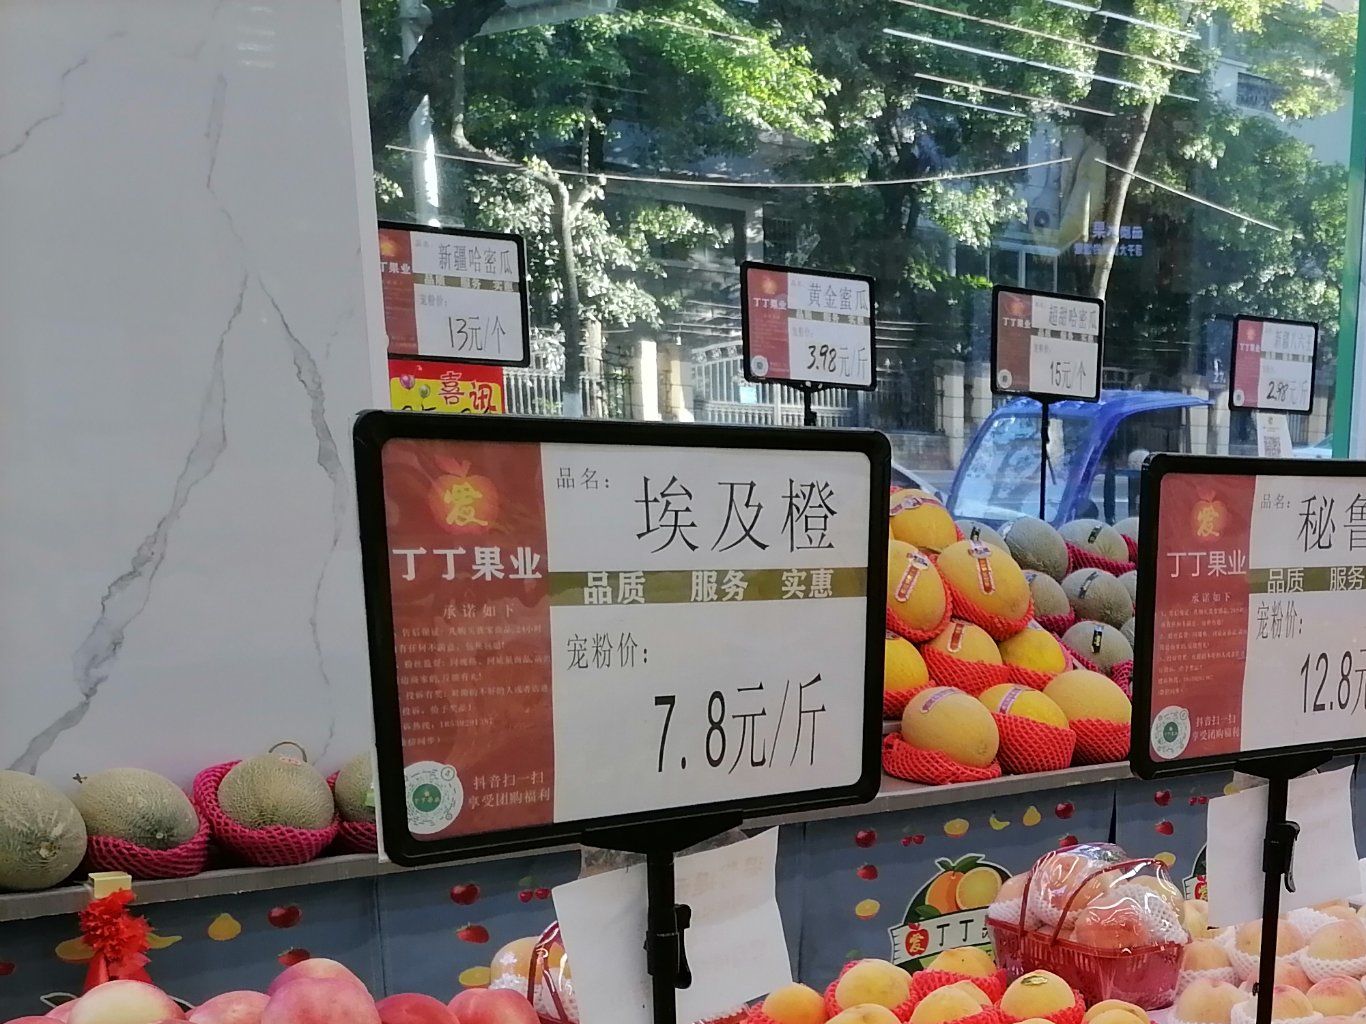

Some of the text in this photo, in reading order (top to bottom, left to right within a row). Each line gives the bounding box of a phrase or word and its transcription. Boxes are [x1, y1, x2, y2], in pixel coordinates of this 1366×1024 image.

[438, 243, 512, 274] 新疆哈密瓜
[448, 316, 506, 354] 13元/个
[438, 370, 498, 413] 喜讯
[556, 466, 838, 554] 品名： 埃及橙
[392, 546, 543, 582] 丁丁果业
[1167, 550, 1248, 579] 丁丁果业
[1267, 567, 1305, 594] 品质
[1330, 566, 1365, 591] 服务
[583, 568, 836, 606] 品质 服务 实惠
[443, 603, 516, 620] 承诺如下
[565, 631, 650, 670] 宠粉价：
[654, 673, 828, 775] 7.8元/斤
[468, 787, 551, 810] 享受团购福利
[473, 770, 545, 791] 抖音扫一扫
